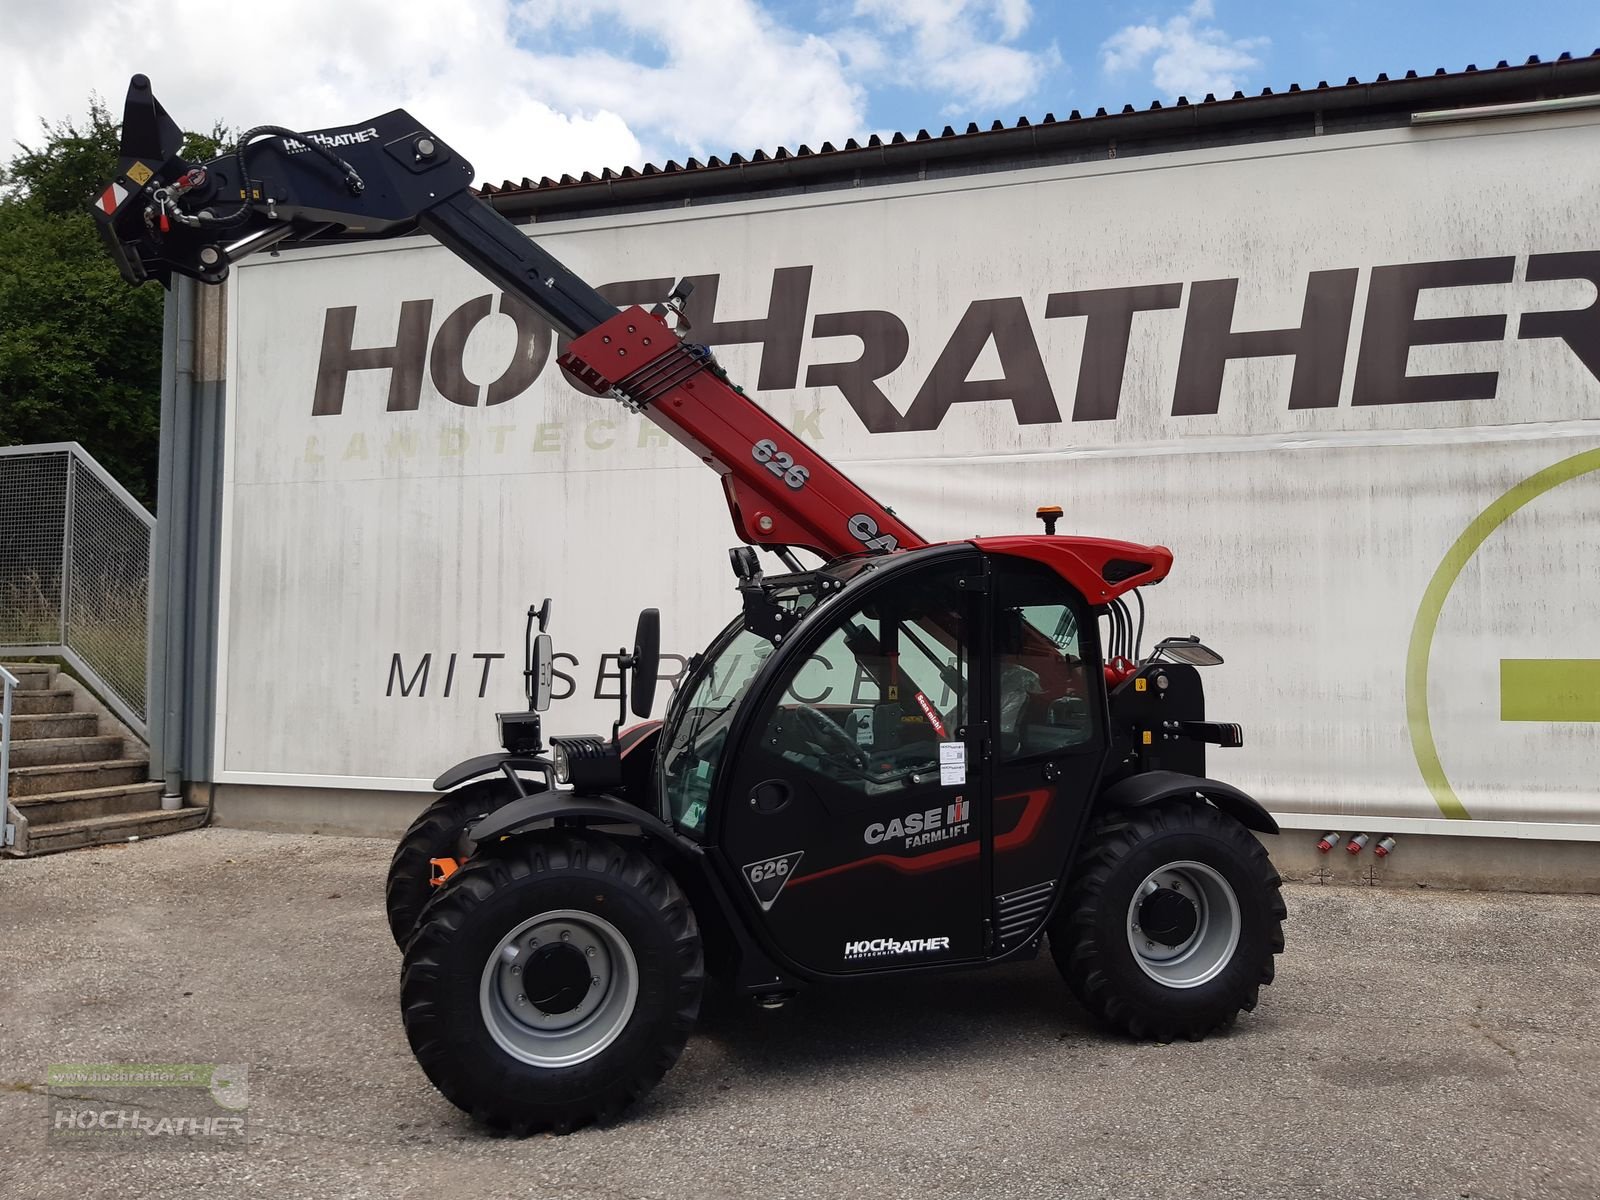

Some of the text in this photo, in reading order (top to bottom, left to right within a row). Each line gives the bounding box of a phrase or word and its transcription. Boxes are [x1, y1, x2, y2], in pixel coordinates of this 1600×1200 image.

[303, 408, 826, 463] LANDTECHK
[752, 439, 810, 489] 626
[386, 653, 505, 698] MIT
[917, 695, 930, 712] Scan
[864, 808, 942, 845] CASE
[905, 823, 970, 849] FARMLIFT
[751, 858, 789, 883] 626
[845, 937, 950, 954] HOCHRATHER
